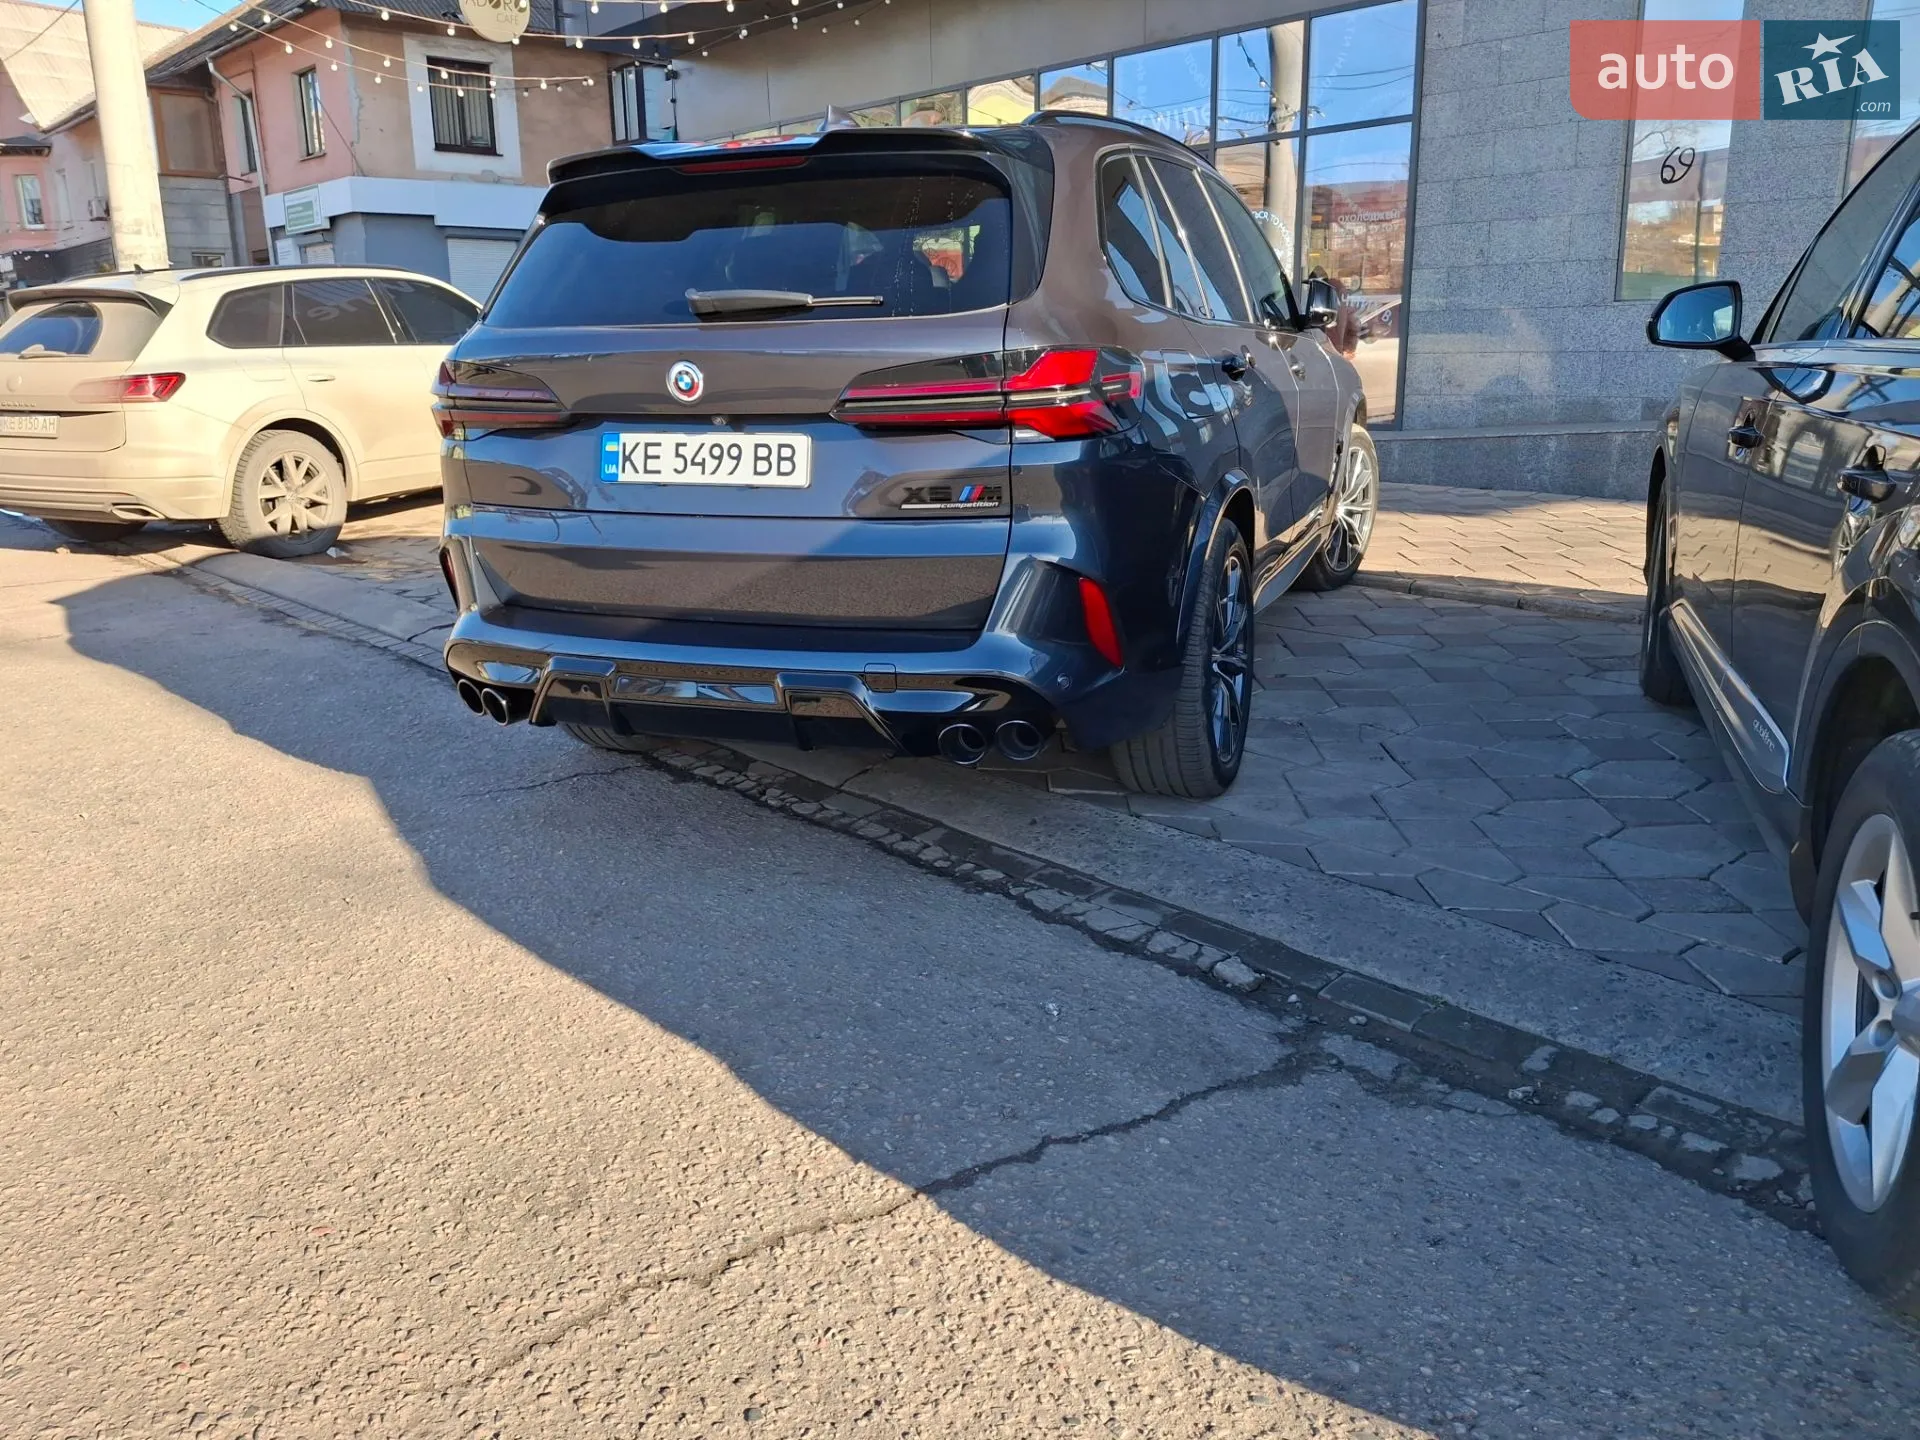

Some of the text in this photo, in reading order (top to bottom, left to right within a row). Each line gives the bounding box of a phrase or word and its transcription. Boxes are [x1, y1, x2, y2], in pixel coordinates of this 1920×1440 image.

[1660, 146, 1696, 184] 69
[604, 464, 618, 475] UA
[621, 442, 796, 477] KE 5499 BB
[902, 486, 952, 503] X5
